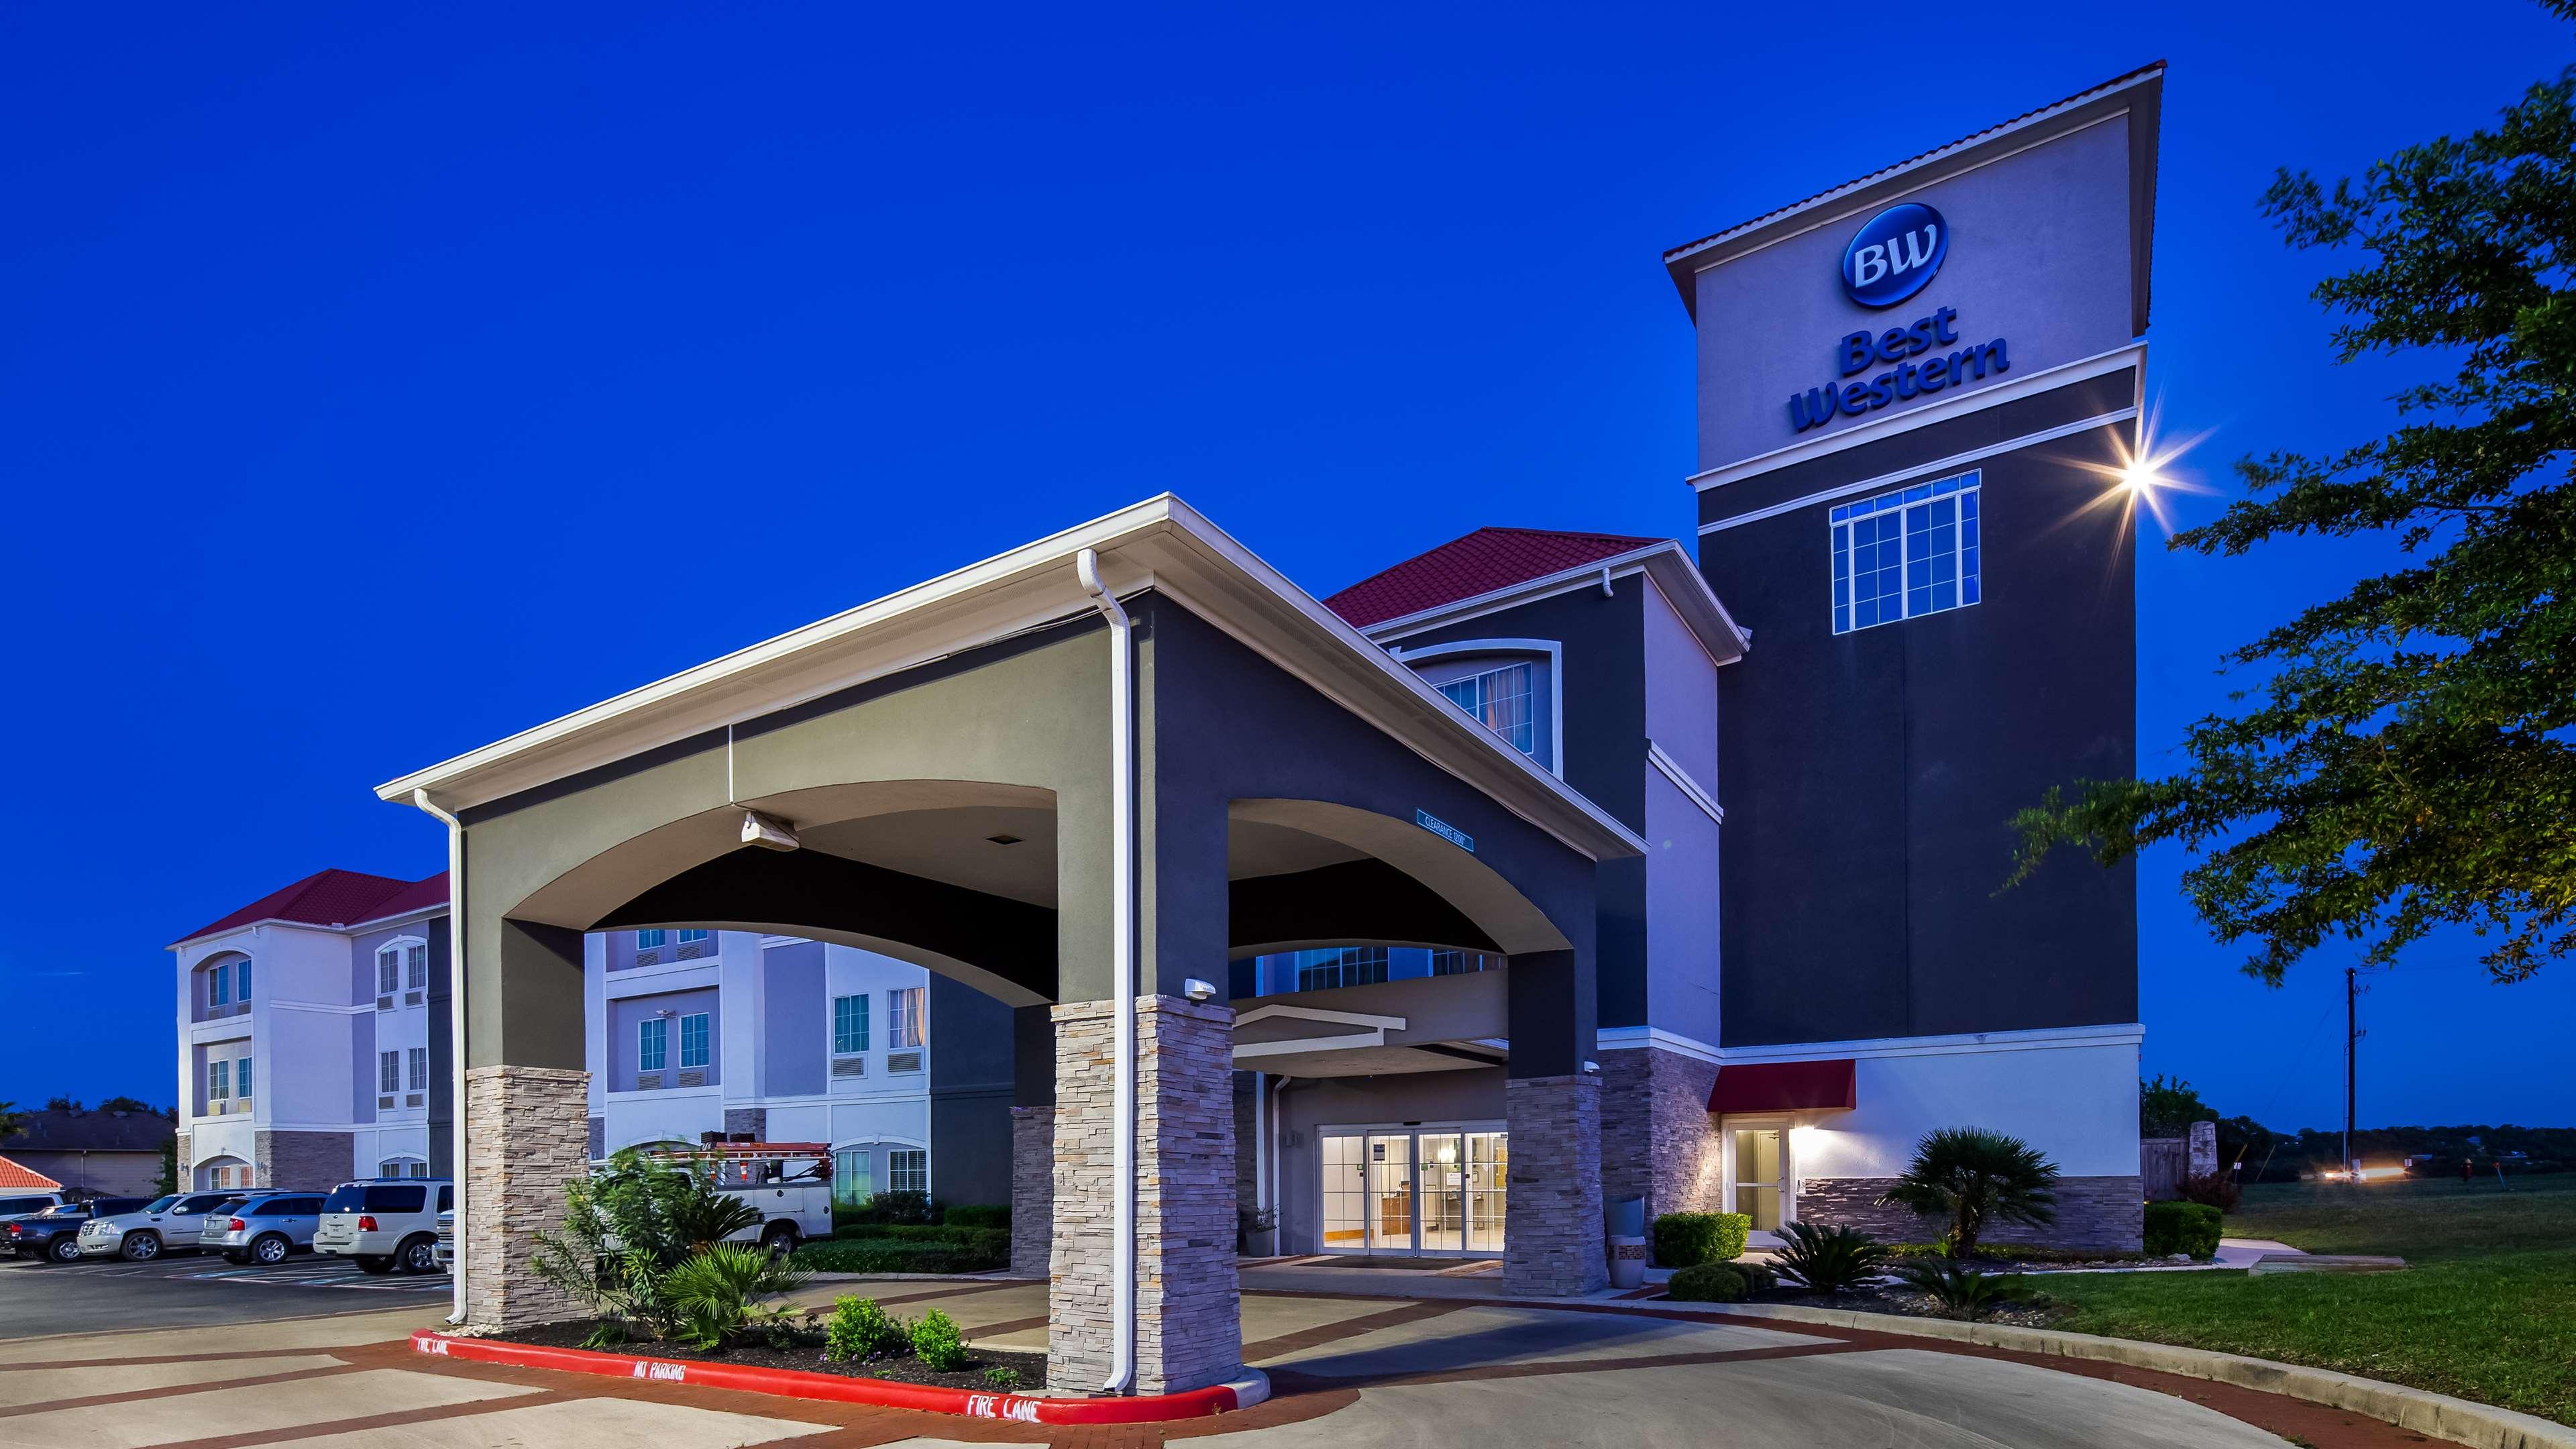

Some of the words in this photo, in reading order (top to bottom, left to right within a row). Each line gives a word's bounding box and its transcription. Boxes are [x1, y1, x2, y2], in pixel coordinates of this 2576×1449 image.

[1855, 224, 1937, 288] BW
[1840, 306, 1958, 377] Best
[1790, 338, 2010, 433] Western
[1426, 816, 1452, 839] CLEARANCE
[633, 1360, 648, 1377] NO
[649, 1362, 686, 1381] PARKING
[967, 1395, 999, 1418] FIRE
[1003, 1398, 1042, 1423] LANE
